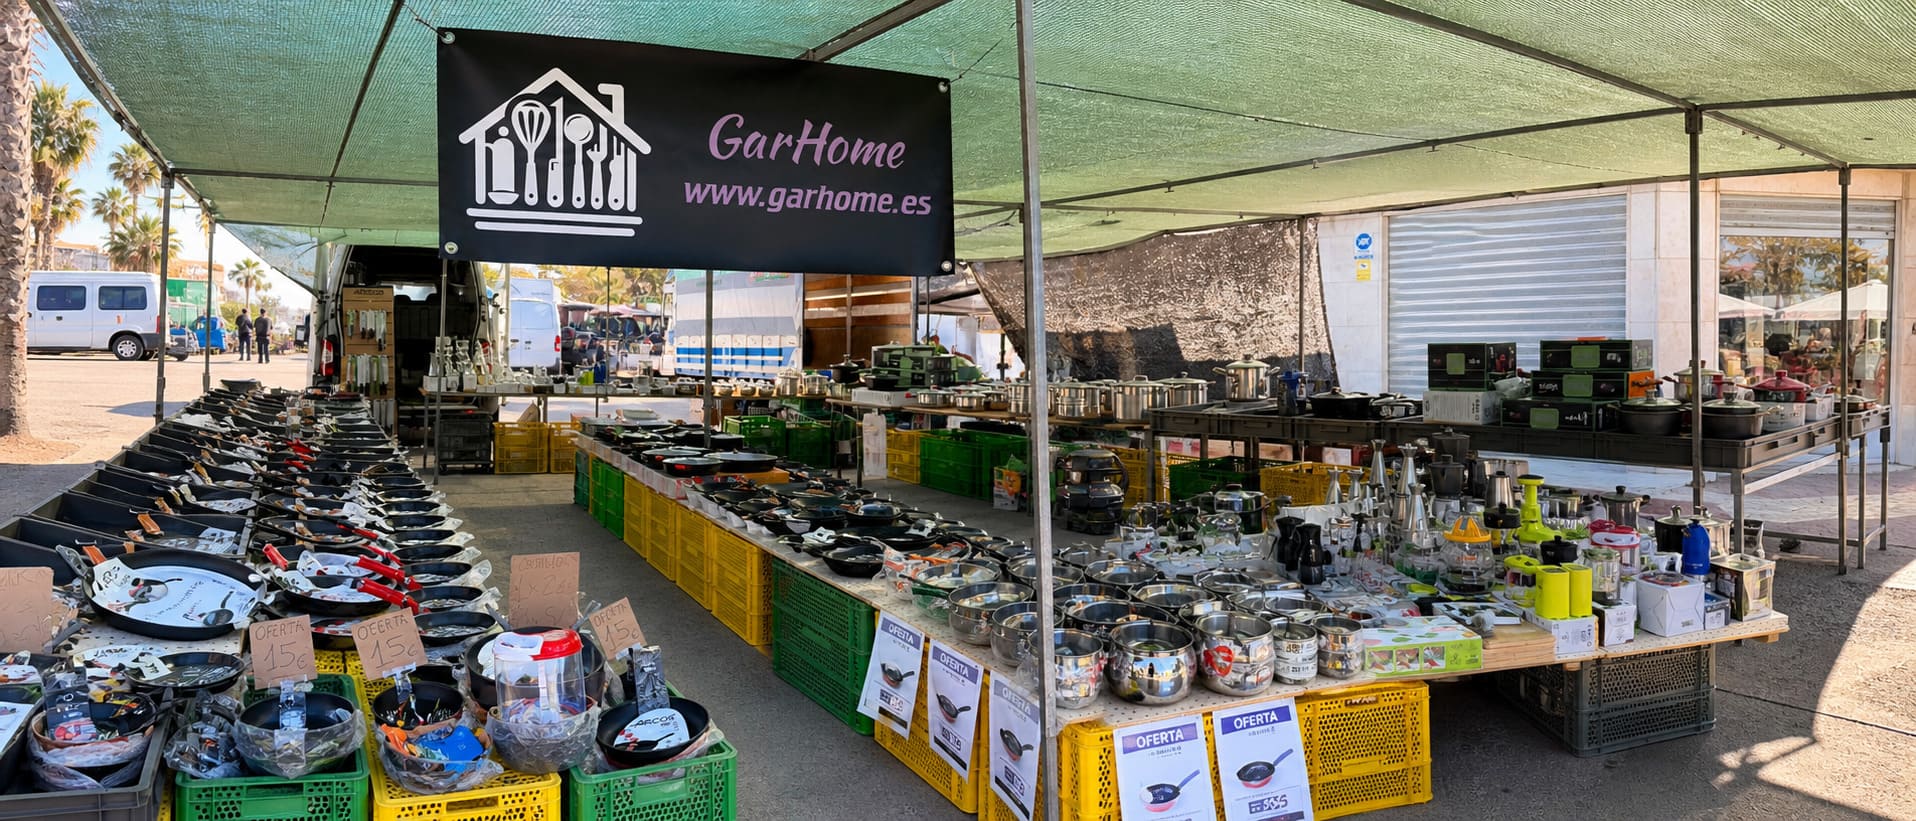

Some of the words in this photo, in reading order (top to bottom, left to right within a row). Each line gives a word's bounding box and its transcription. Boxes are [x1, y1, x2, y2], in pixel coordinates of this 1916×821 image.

[709, 113, 906, 169] GarHome
[684, 181, 932, 215] www.garhome.es
[255, 620, 305, 641] OFERTA
[264, 641, 308, 672] 15€
[1233, 710, 1279, 730] OFERTA
[1136, 728, 1185, 749] OFERTA
